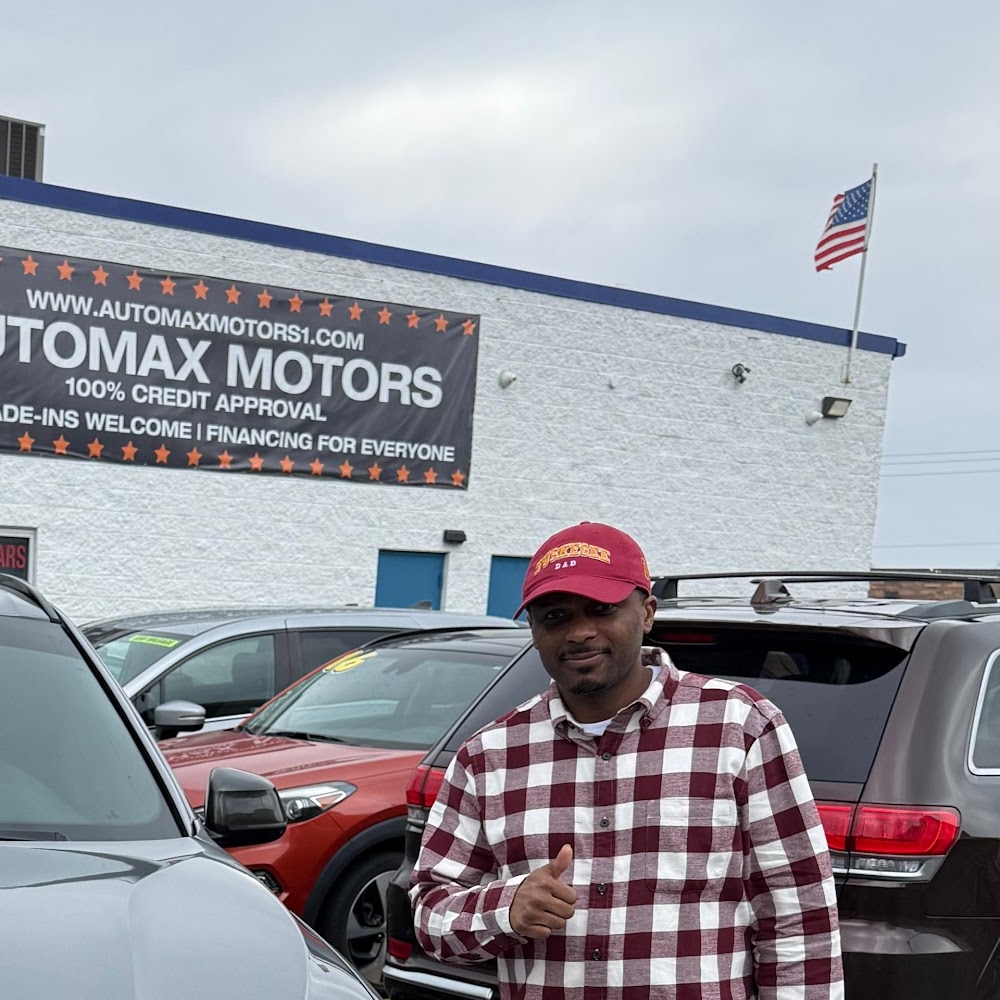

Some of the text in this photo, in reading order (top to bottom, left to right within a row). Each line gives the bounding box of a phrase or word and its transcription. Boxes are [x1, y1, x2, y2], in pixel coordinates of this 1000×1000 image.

[26, 288, 365, 350] WWW.AUTOMAXMOTORS1.COM
[65, 377, 328, 421] 100% CREDIT APPROVAL
[226, 344, 443, 408] MOTORS
[85, 411, 193, 440] WELCOME
[206, 424, 313, 450] FINANCING
[317, 436, 357, 454] FOR
[360, 439, 456, 462] EVERYONE
[554, 560, 577, 570] DAD
